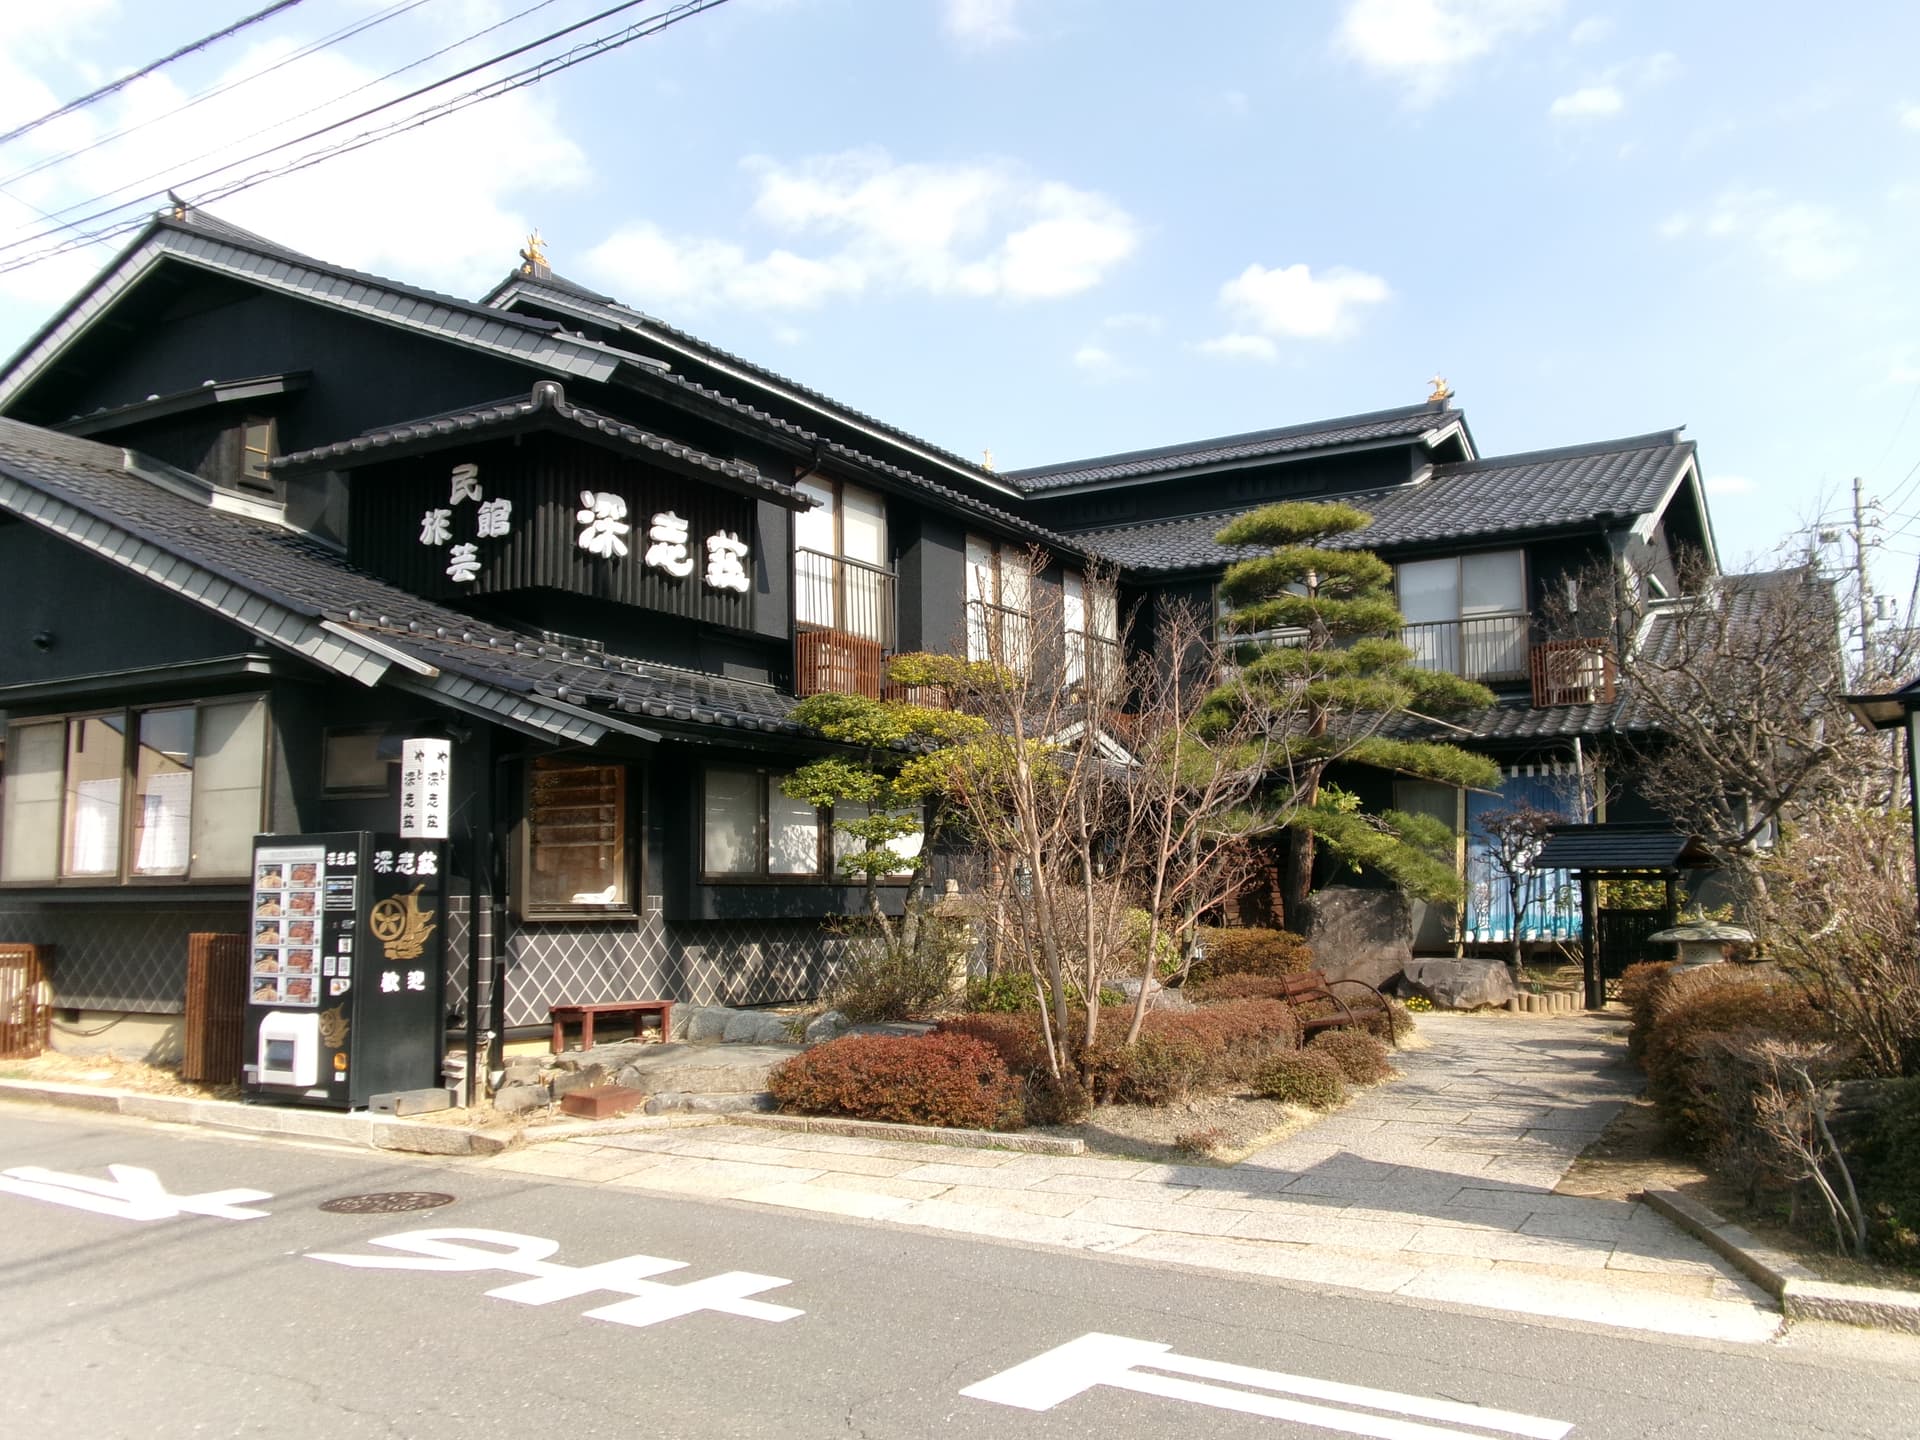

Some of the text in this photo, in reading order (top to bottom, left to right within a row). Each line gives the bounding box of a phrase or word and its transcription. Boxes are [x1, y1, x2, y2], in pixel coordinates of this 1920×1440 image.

[576, 490, 751, 593] 深志荘
[373, 850, 438, 876] 深志荘
